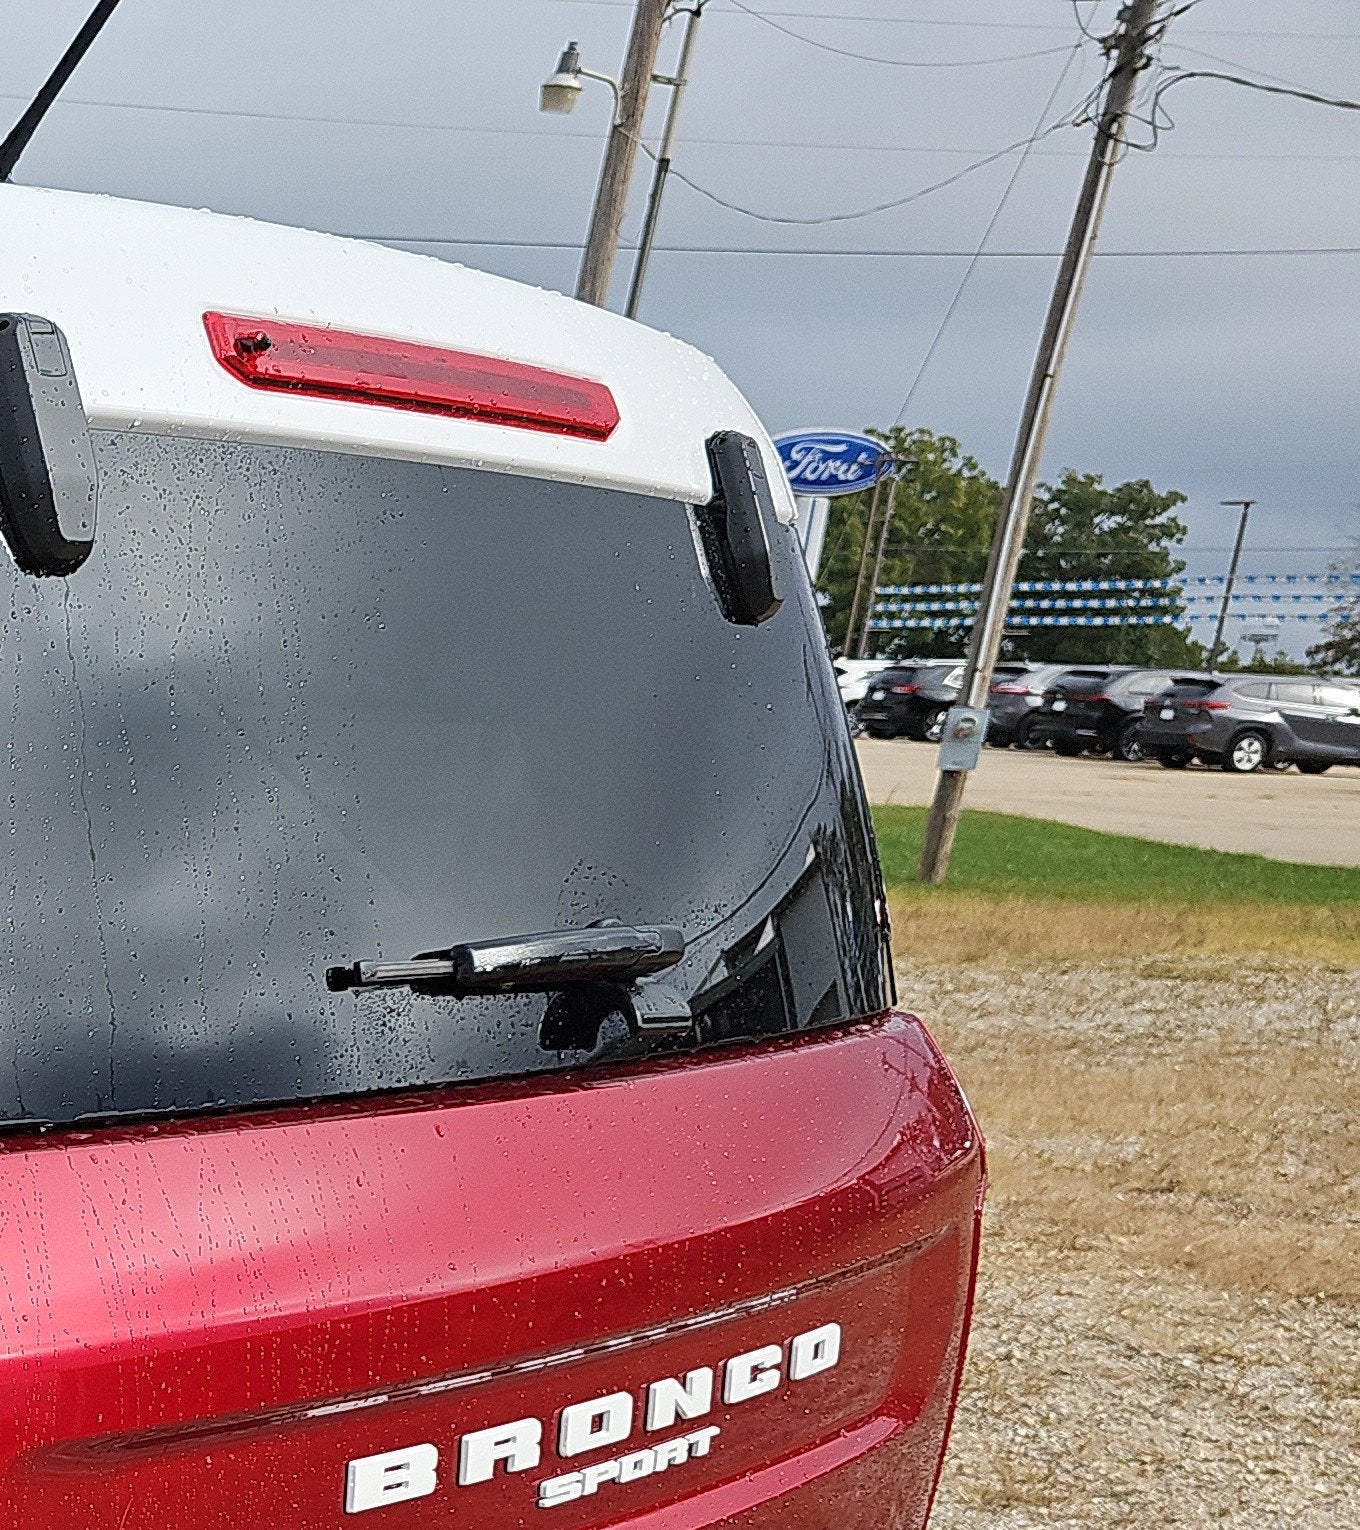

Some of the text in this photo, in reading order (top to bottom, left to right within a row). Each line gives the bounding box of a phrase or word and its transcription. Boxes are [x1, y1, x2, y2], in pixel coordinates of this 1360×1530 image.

[784, 441, 870, 481] Ford
[344, 1322, 842, 1514] BRONCO
[536, 1425, 721, 1509] SPORT
